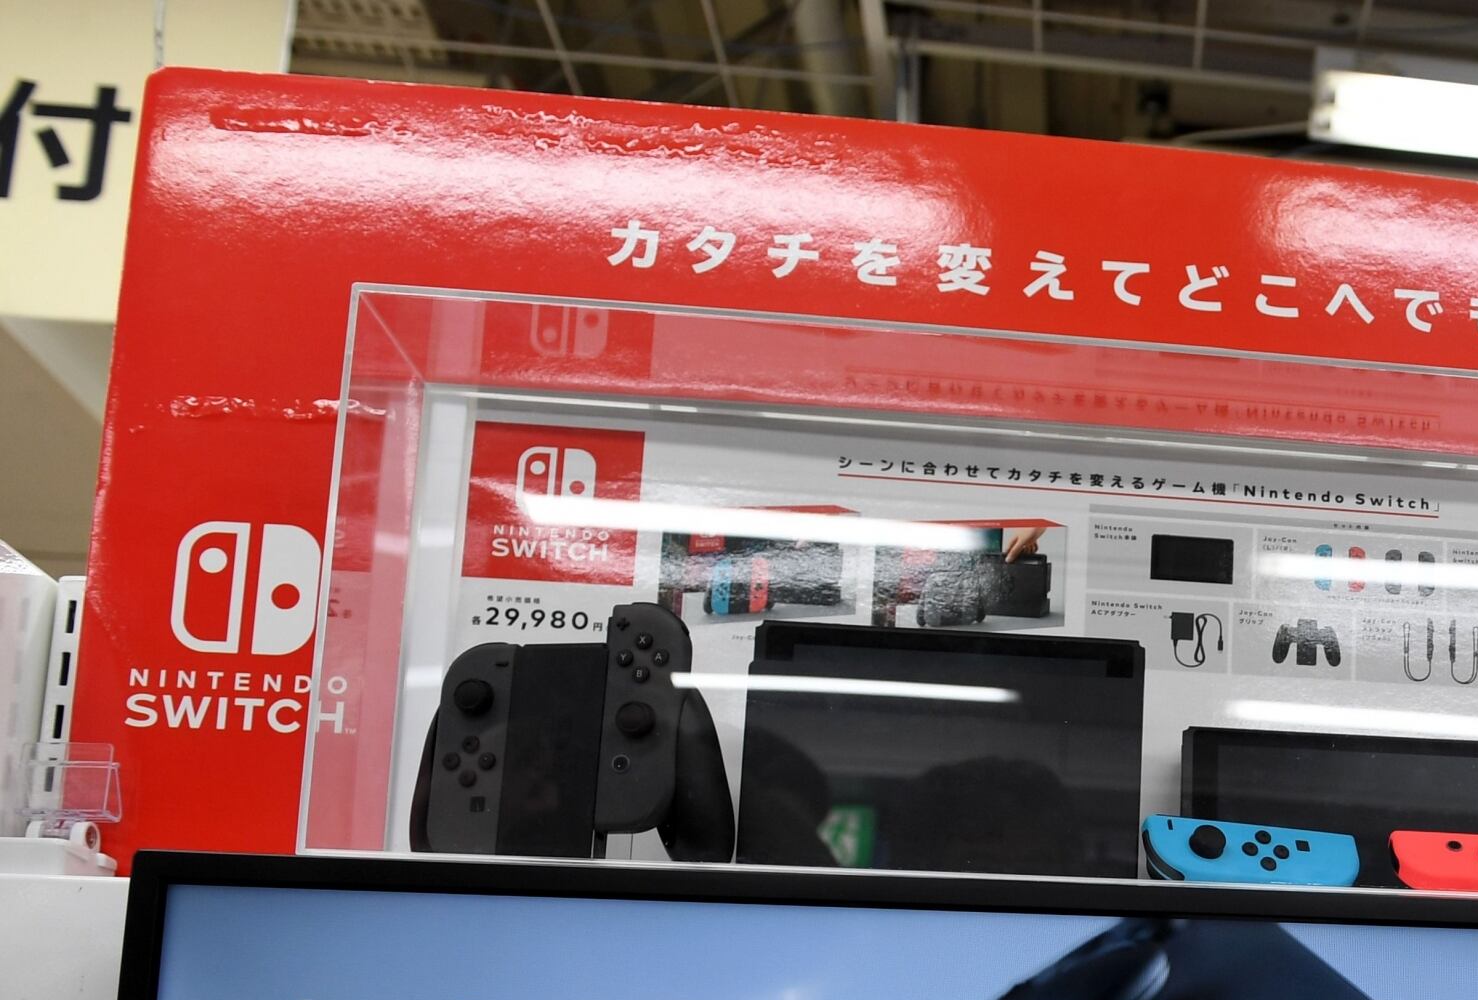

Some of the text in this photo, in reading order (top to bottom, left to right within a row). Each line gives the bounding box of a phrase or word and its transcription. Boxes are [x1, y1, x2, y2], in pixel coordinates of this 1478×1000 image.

[493, 524, 609, 541] NINTENDO
[1094, 524, 1133, 532] Nintendo
[491, 538, 608, 562] SWITCH
[1091, 601, 1163, 610] Nintendo Switch
[129, 668, 347, 695] NINTENDO
